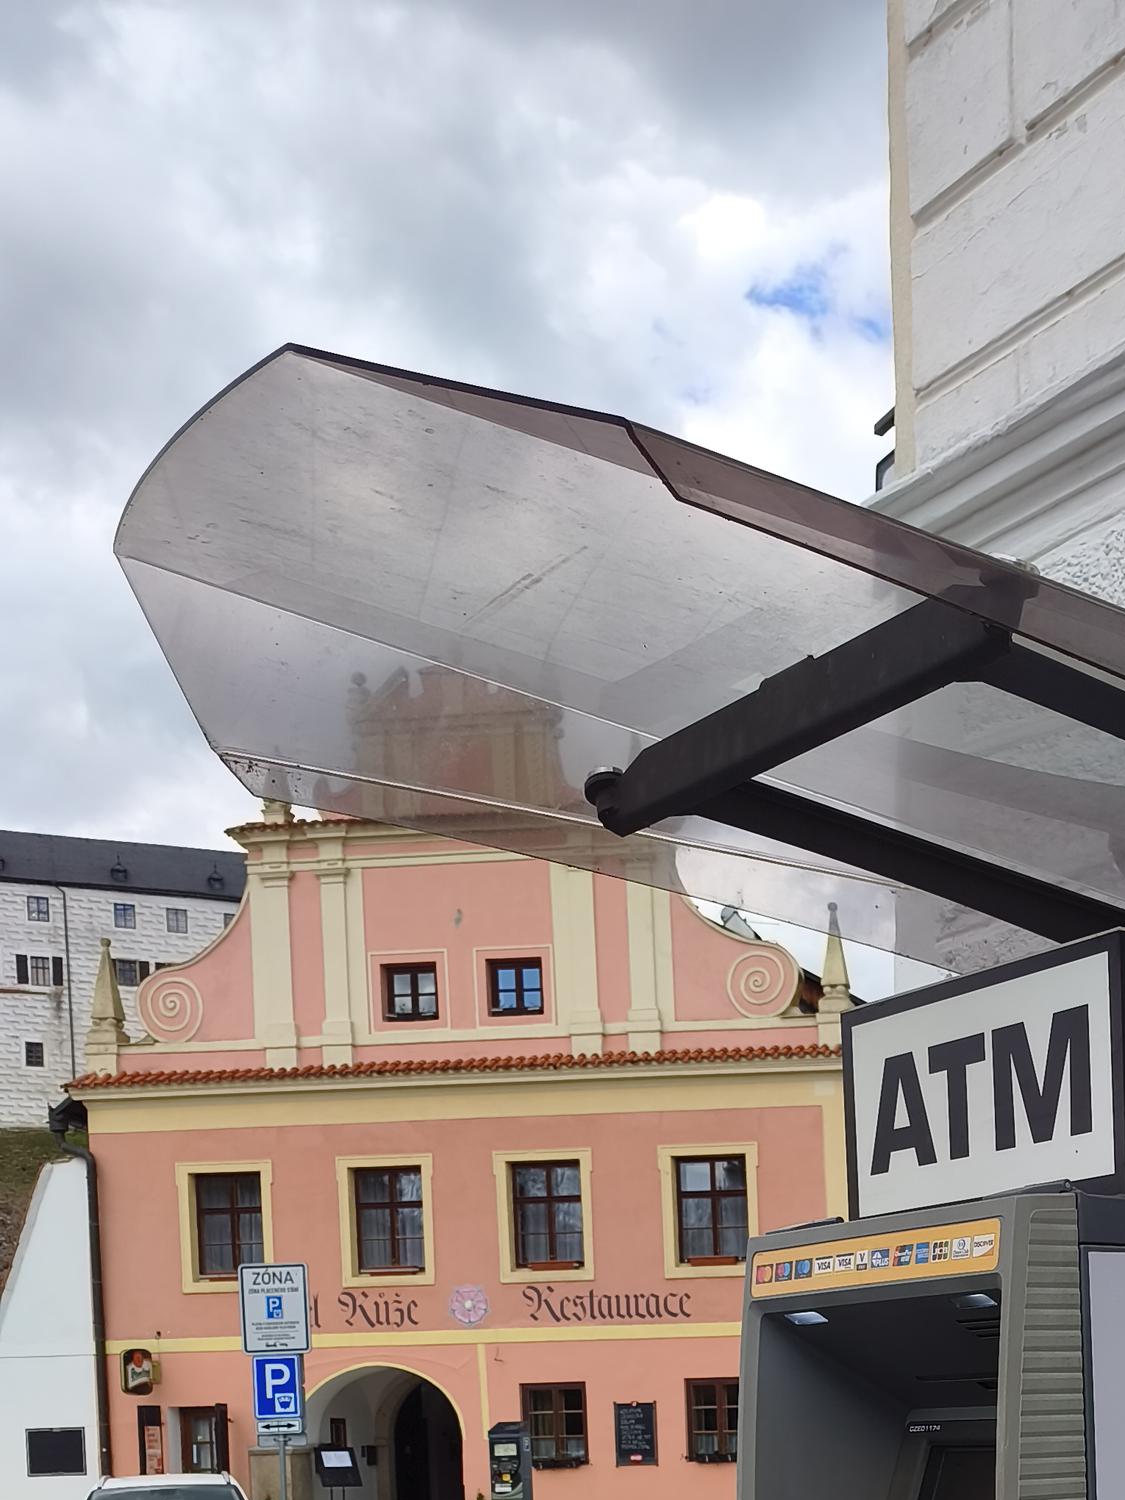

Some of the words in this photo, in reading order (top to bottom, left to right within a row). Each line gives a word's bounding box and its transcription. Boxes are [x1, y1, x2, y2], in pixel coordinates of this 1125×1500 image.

[870, 1004, 1093, 1176] ATM
[816, 1261, 831, 1271] VISA
[838, 1258, 852, 1267] VISA
[875, 1257, 889, 1267] PLUS
[252, 1268, 294, 1286] ZÓNA
[338, 1291, 419, 1328] Růže
[522, 1286, 692, 1323] Restaurace
[265, 1363, 291, 1399] P
